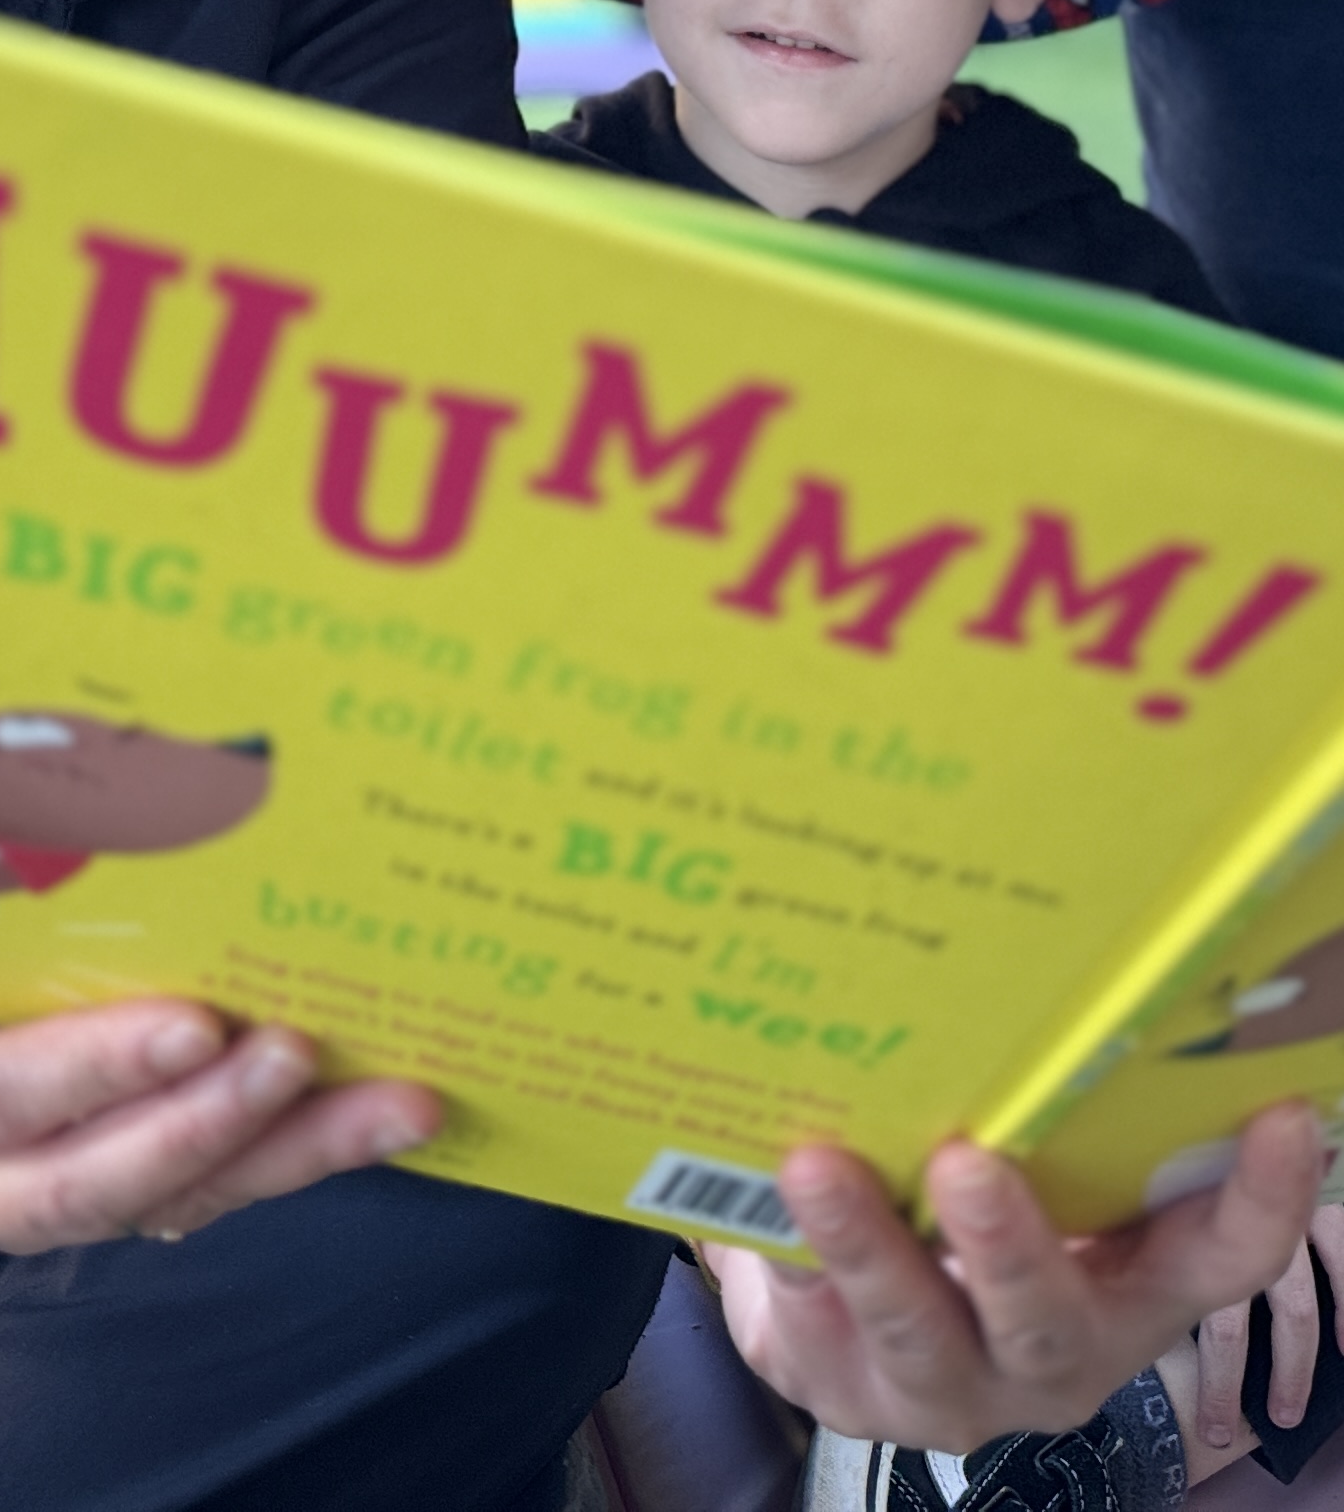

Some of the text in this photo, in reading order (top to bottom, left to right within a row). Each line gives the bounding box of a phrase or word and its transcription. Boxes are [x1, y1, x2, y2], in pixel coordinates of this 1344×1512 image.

[2, 508, 202, 618] BIG
[223, 582, 476, 682] green
[505, 641, 693, 741] frog
[722, 695, 803, 758] in
[831, 725, 972, 793] the
[325, 682, 566, 786] toilet
[554, 821, 735, 907] BIG
[257, 880, 560, 1000] busting
[688, 986, 916, 1070] wee!
[706, 932, 818, 996] I'm
